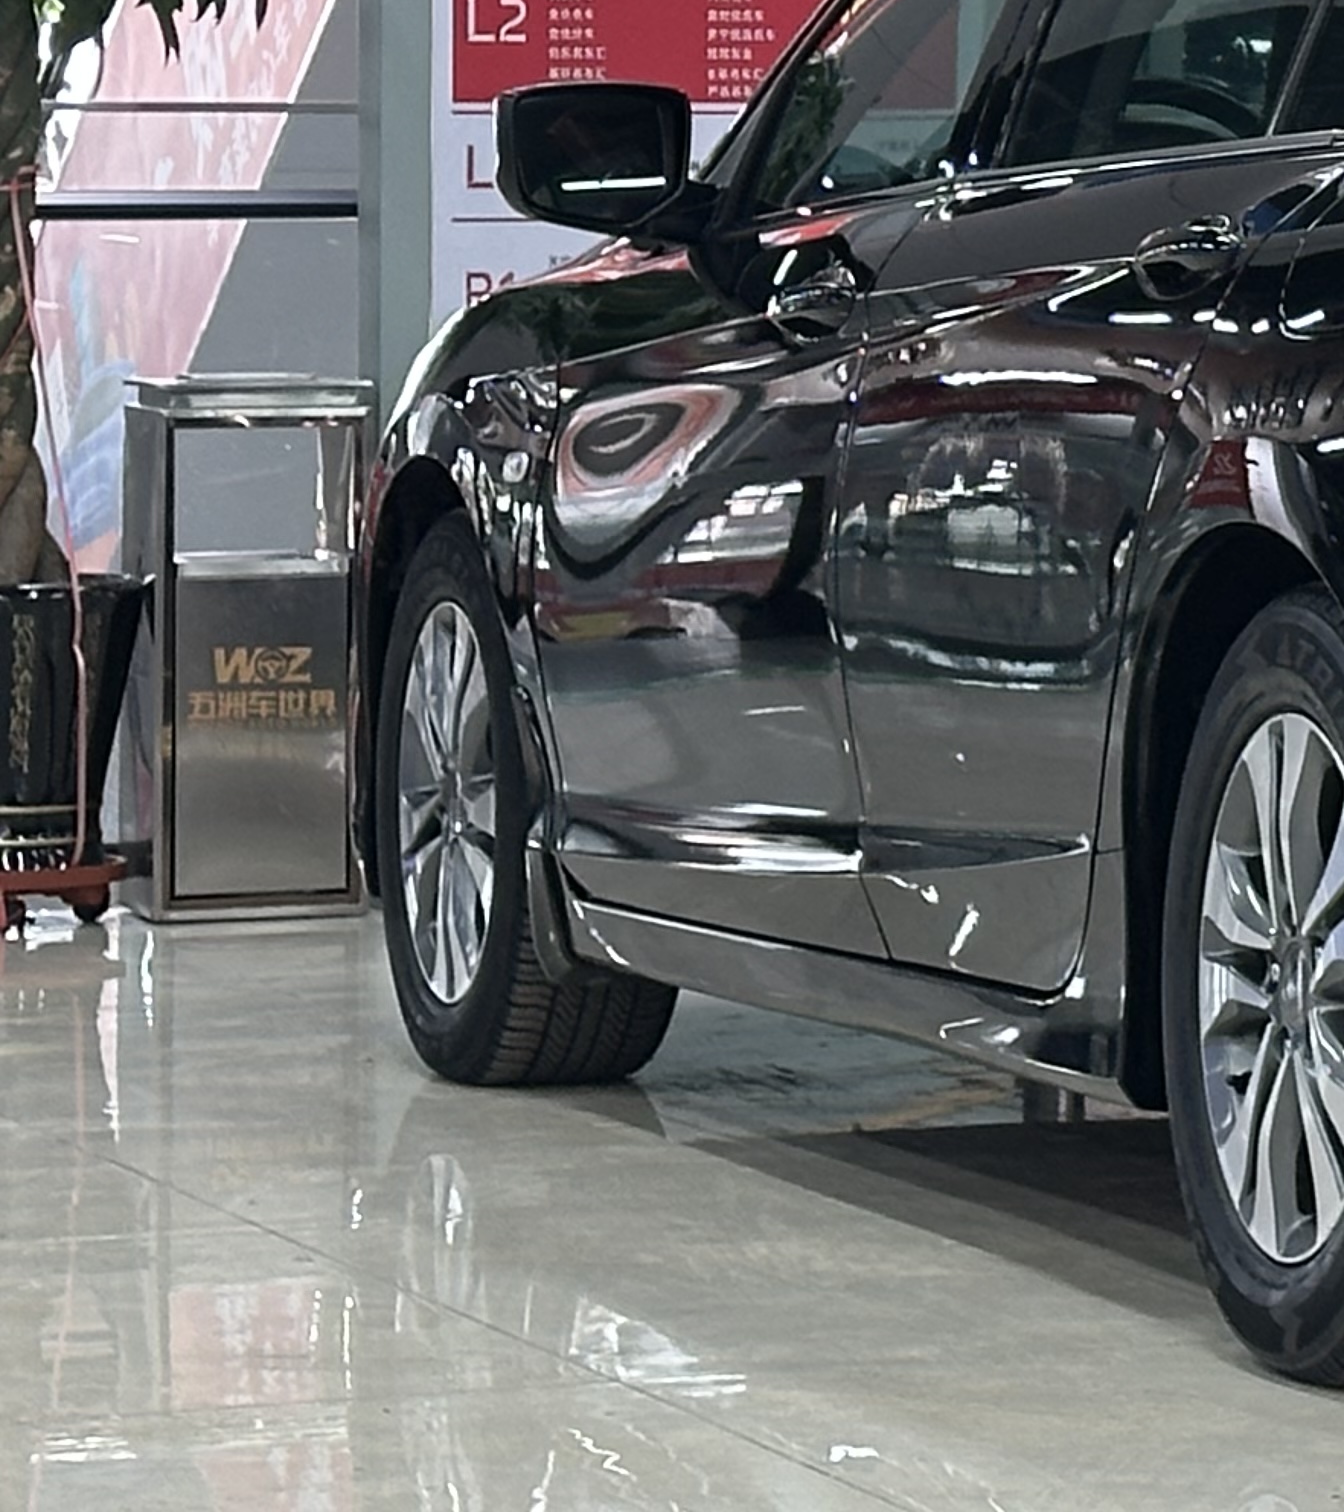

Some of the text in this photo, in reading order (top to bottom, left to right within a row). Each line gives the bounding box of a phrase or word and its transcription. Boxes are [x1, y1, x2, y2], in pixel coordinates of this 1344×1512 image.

[466, 144, 494, 189] L
[187, 688, 338, 722] 五洲车世界
